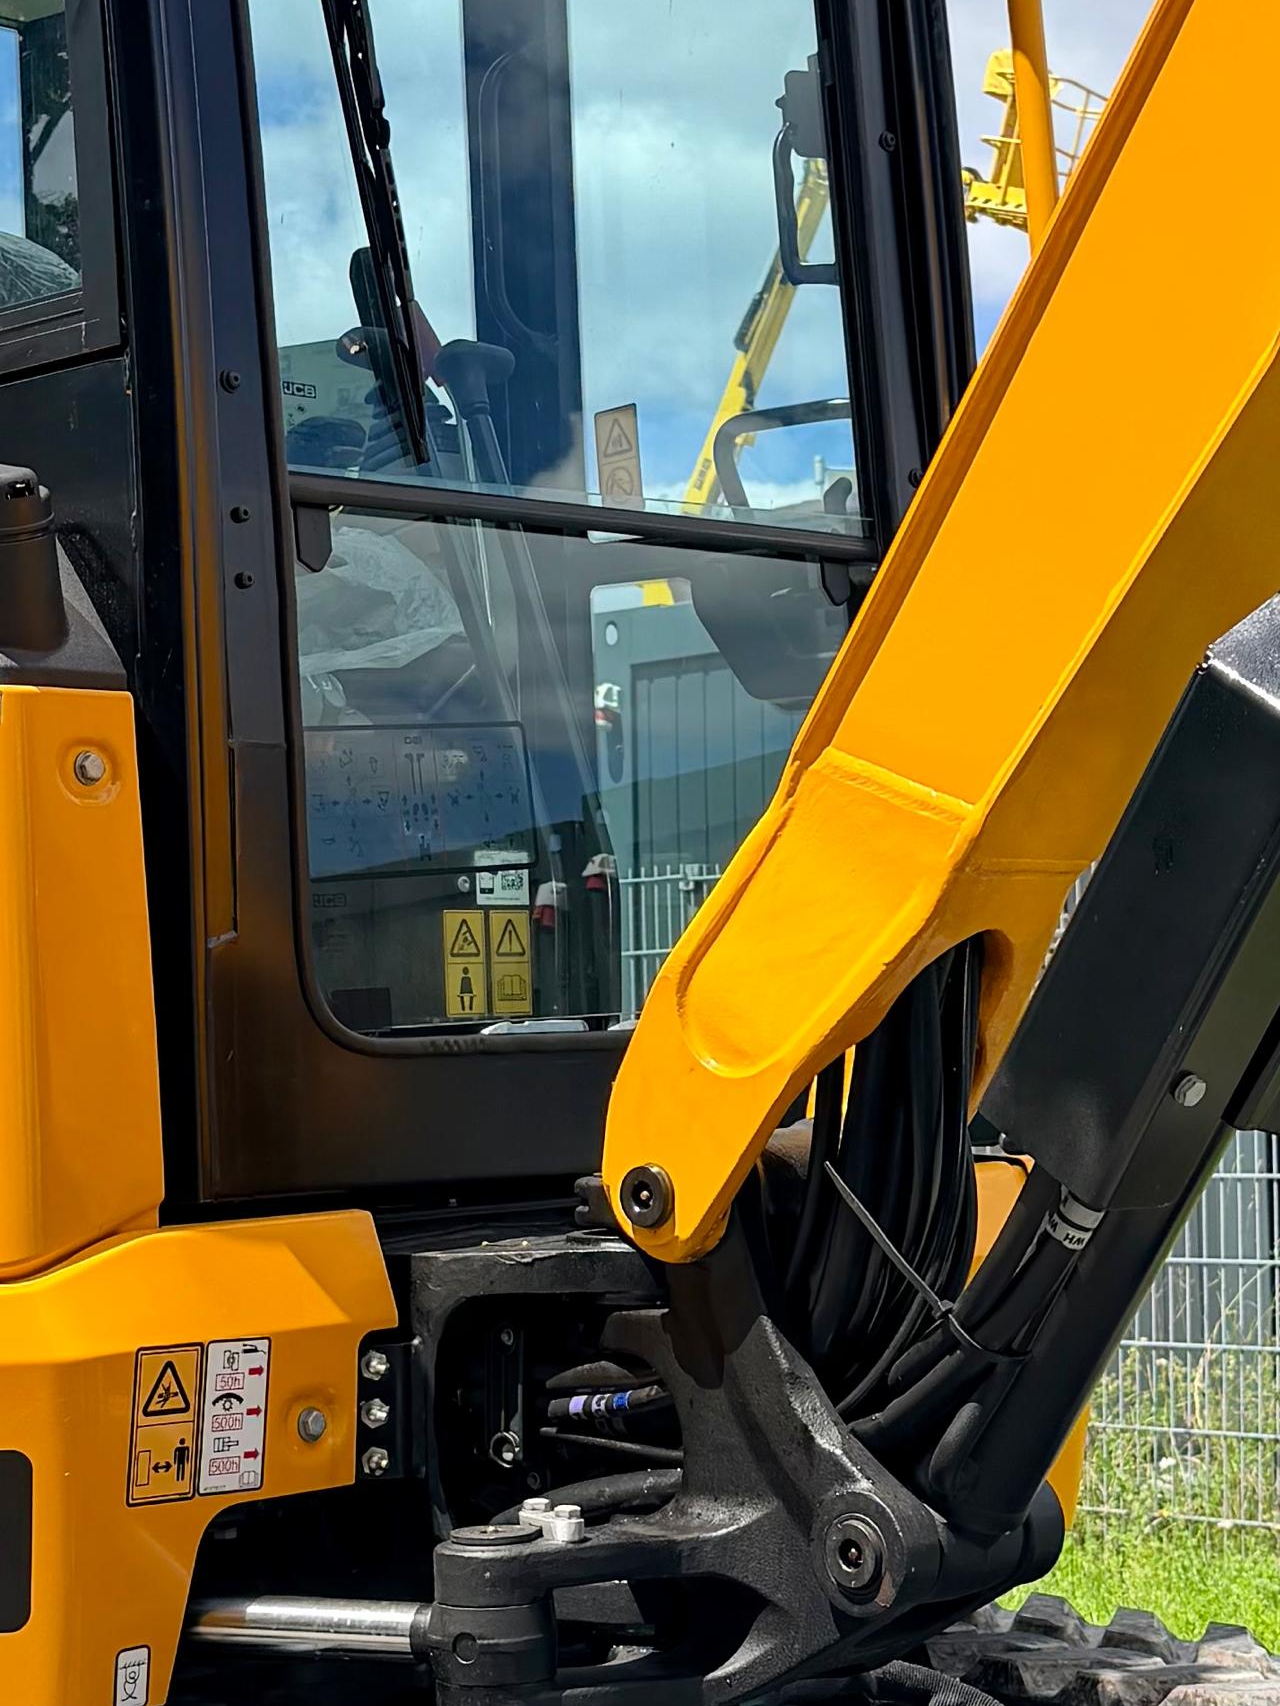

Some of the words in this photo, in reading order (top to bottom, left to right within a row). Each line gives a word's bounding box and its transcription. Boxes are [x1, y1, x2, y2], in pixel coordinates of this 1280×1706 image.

[284, 382, 315, 398] JCB
[219, 1376, 242, 1389] 50h
[214, 1416, 242, 1430] 500h
[211, 1460, 239, 1474] 500h
